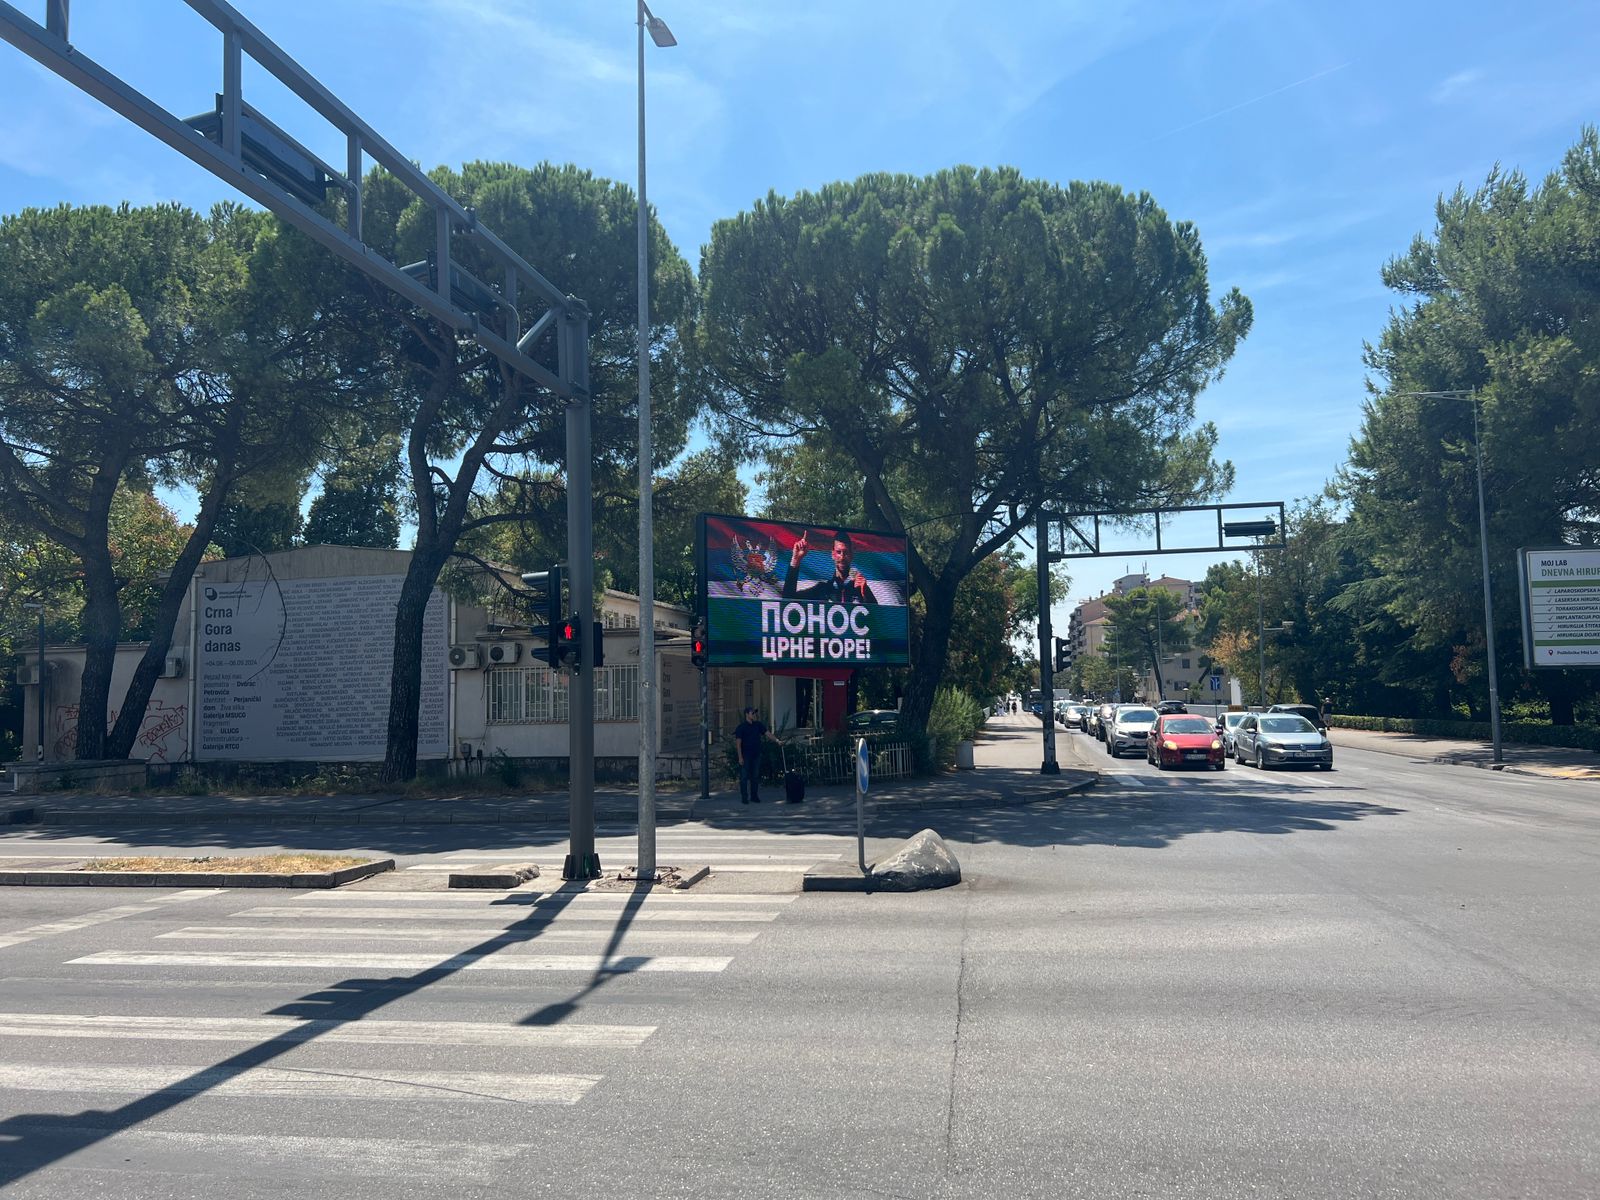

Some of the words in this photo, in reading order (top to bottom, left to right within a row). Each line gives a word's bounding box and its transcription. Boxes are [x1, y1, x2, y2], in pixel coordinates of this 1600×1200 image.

[1542, 568, 1574, 576] DNEVNA
[205, 607, 232, 618] Crna
[761, 601, 870, 636] ПОНОС
[205, 624, 232, 635] Gora
[205, 640, 241, 652] danas
[762, 636, 814, 661] ЦРНЕ
[820, 638, 871, 659] ГОРЕ!
